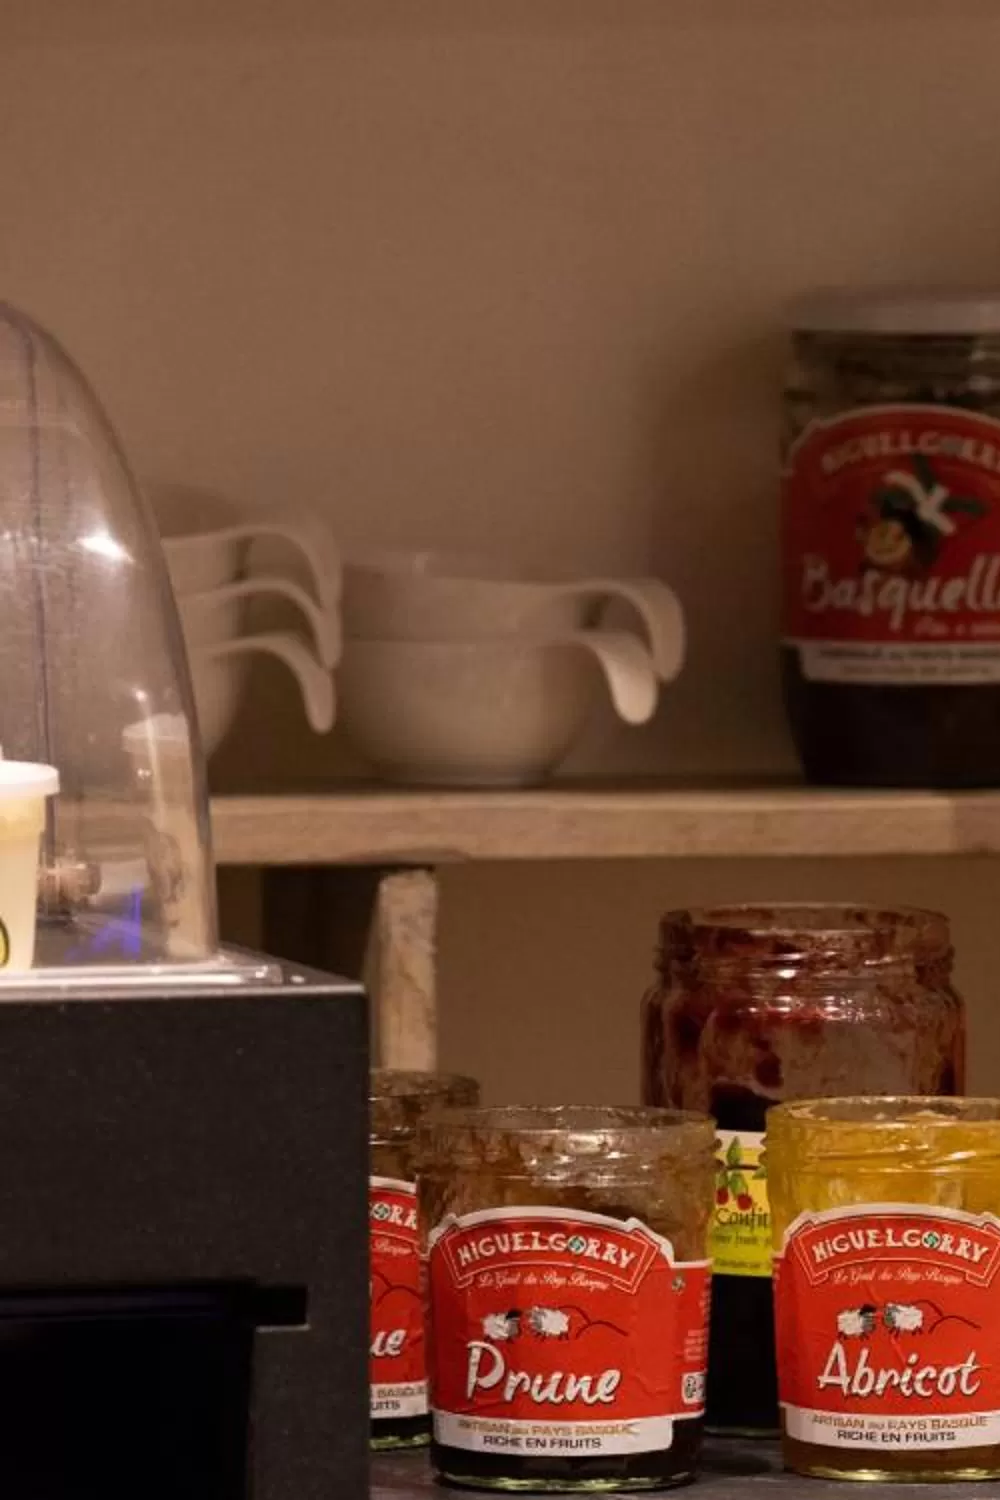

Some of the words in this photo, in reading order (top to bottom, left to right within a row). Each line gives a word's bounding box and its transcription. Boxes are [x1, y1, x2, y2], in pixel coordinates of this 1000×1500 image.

[457, 1231, 637, 1269] MIGUELGORRY
[812, 1228, 989, 1263] MIGUELGORRY
[465, 1341, 622, 1405] Prune
[817, 1341, 986, 1397] Abricot
[837, 1430, 877, 1442] RICHE
[881, 1432, 901, 1443] EN
[905, 1431, 956, 1442] FRUITS
[931, 1416, 989, 1430] BASQUE
[483, 1435, 522, 1448] RICHE
[526, 1437, 547, 1448] EN
[550, 1437, 602, 1449] FRUITS
